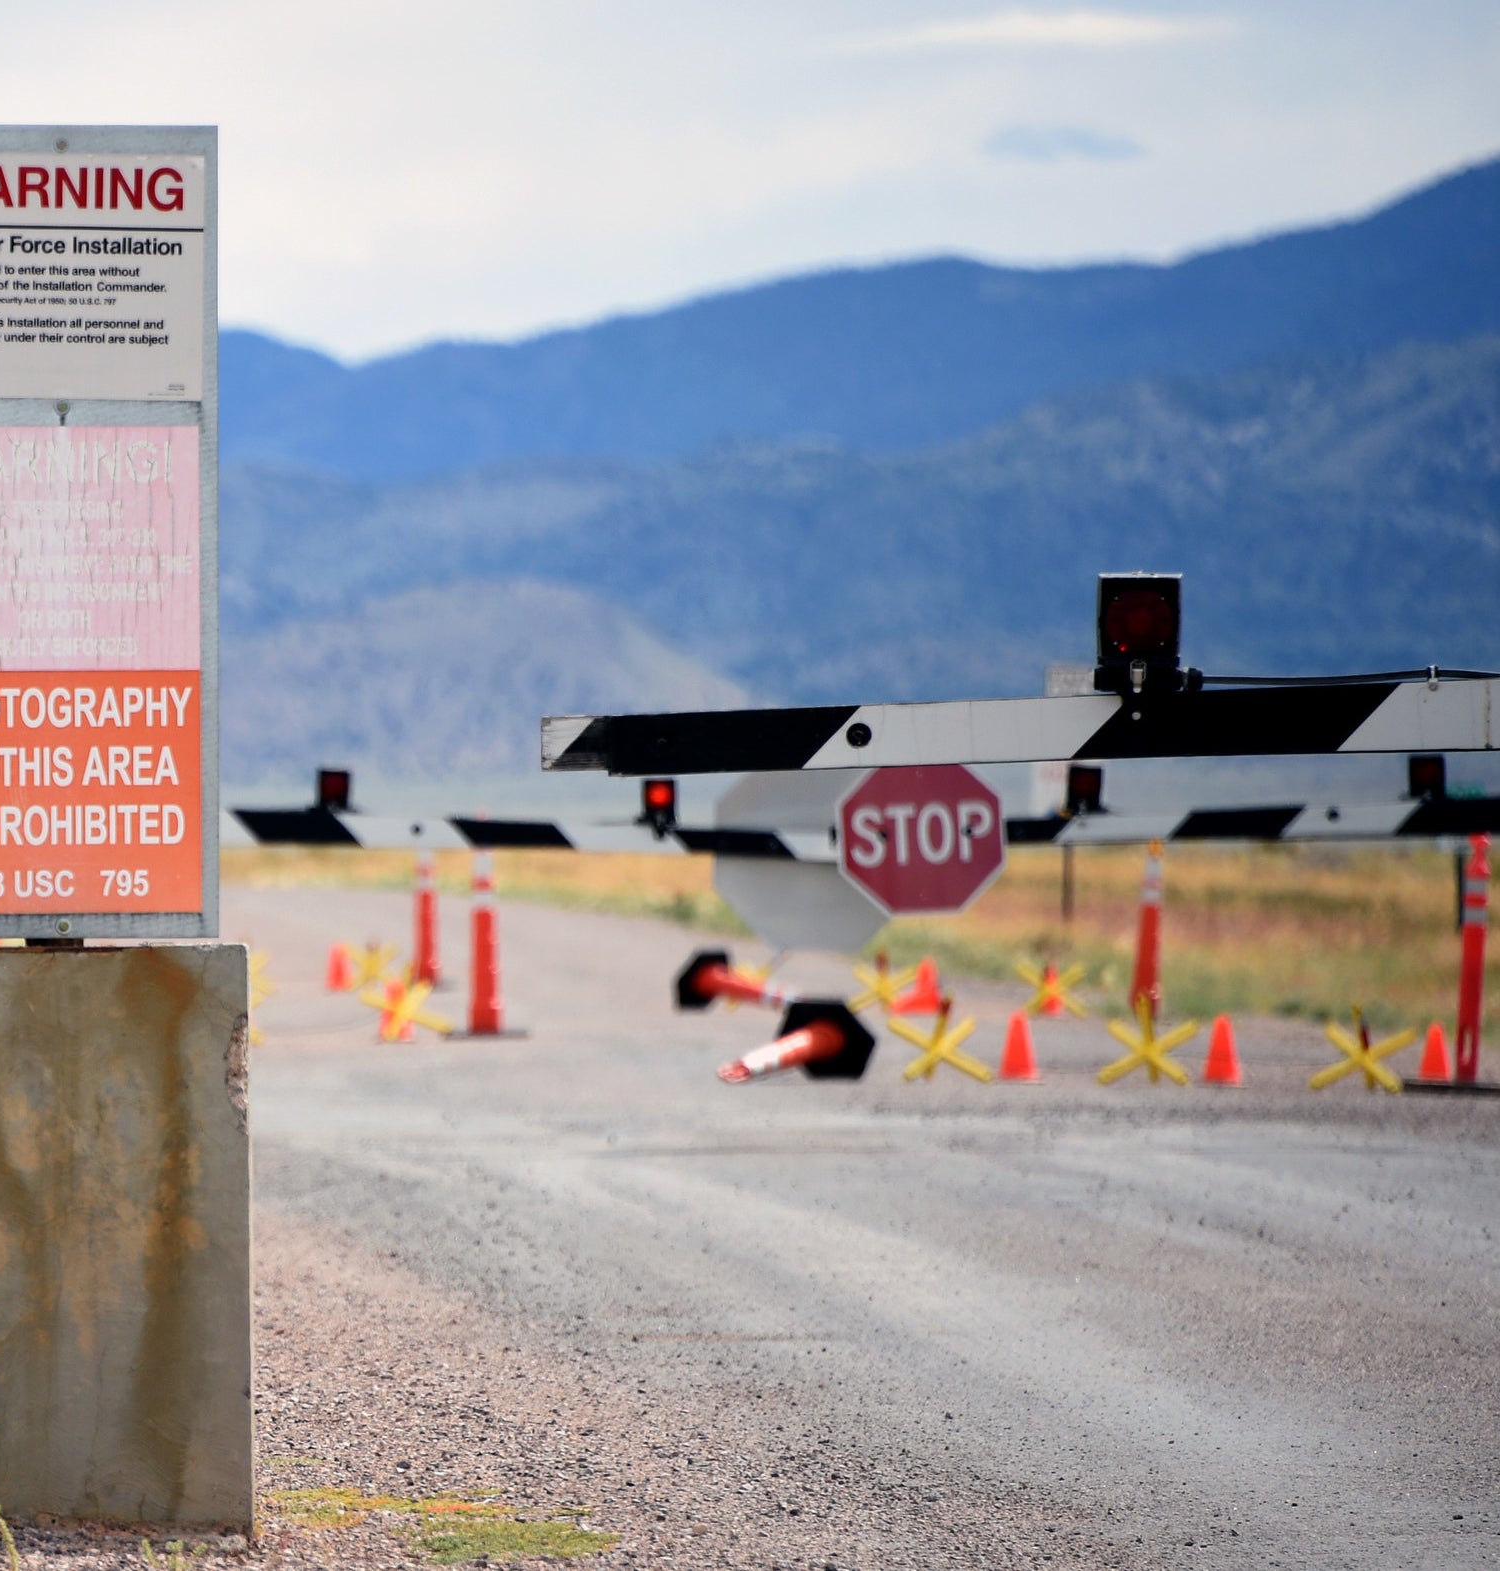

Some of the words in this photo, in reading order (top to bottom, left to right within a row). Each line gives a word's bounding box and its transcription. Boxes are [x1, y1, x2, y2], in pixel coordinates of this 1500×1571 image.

[10, 236, 65, 254] Force
[73, 237, 182, 255] Installation
[5, 266, 15, 275] to
[18, 266, 46, 275] enter
[49, 266, 69, 275] this
[72, 268, 95, 276] area
[99, 267, 140, 277] without
[13, 281, 29, 290] the
[33, 281, 92, 292] Installation
[97, 282, 166, 292] Commander.
[8, 317, 66, 328] Installation
[70, 319, 81, 328] all
[85, 319, 140, 330] personnel
[143, 320, 164, 329] and
[4, 333, 36, 343] under
[39, 333, 63, 343] their
[67, 334, 104, 344] control
[108, 336, 125, 344] are
[129, 335, 168, 346] subject
[82, 746, 179, 786] AREA
[851, 802, 993, 868] STOP
[14, 870, 74, 897] USC
[100, 869, 148, 897] 795
